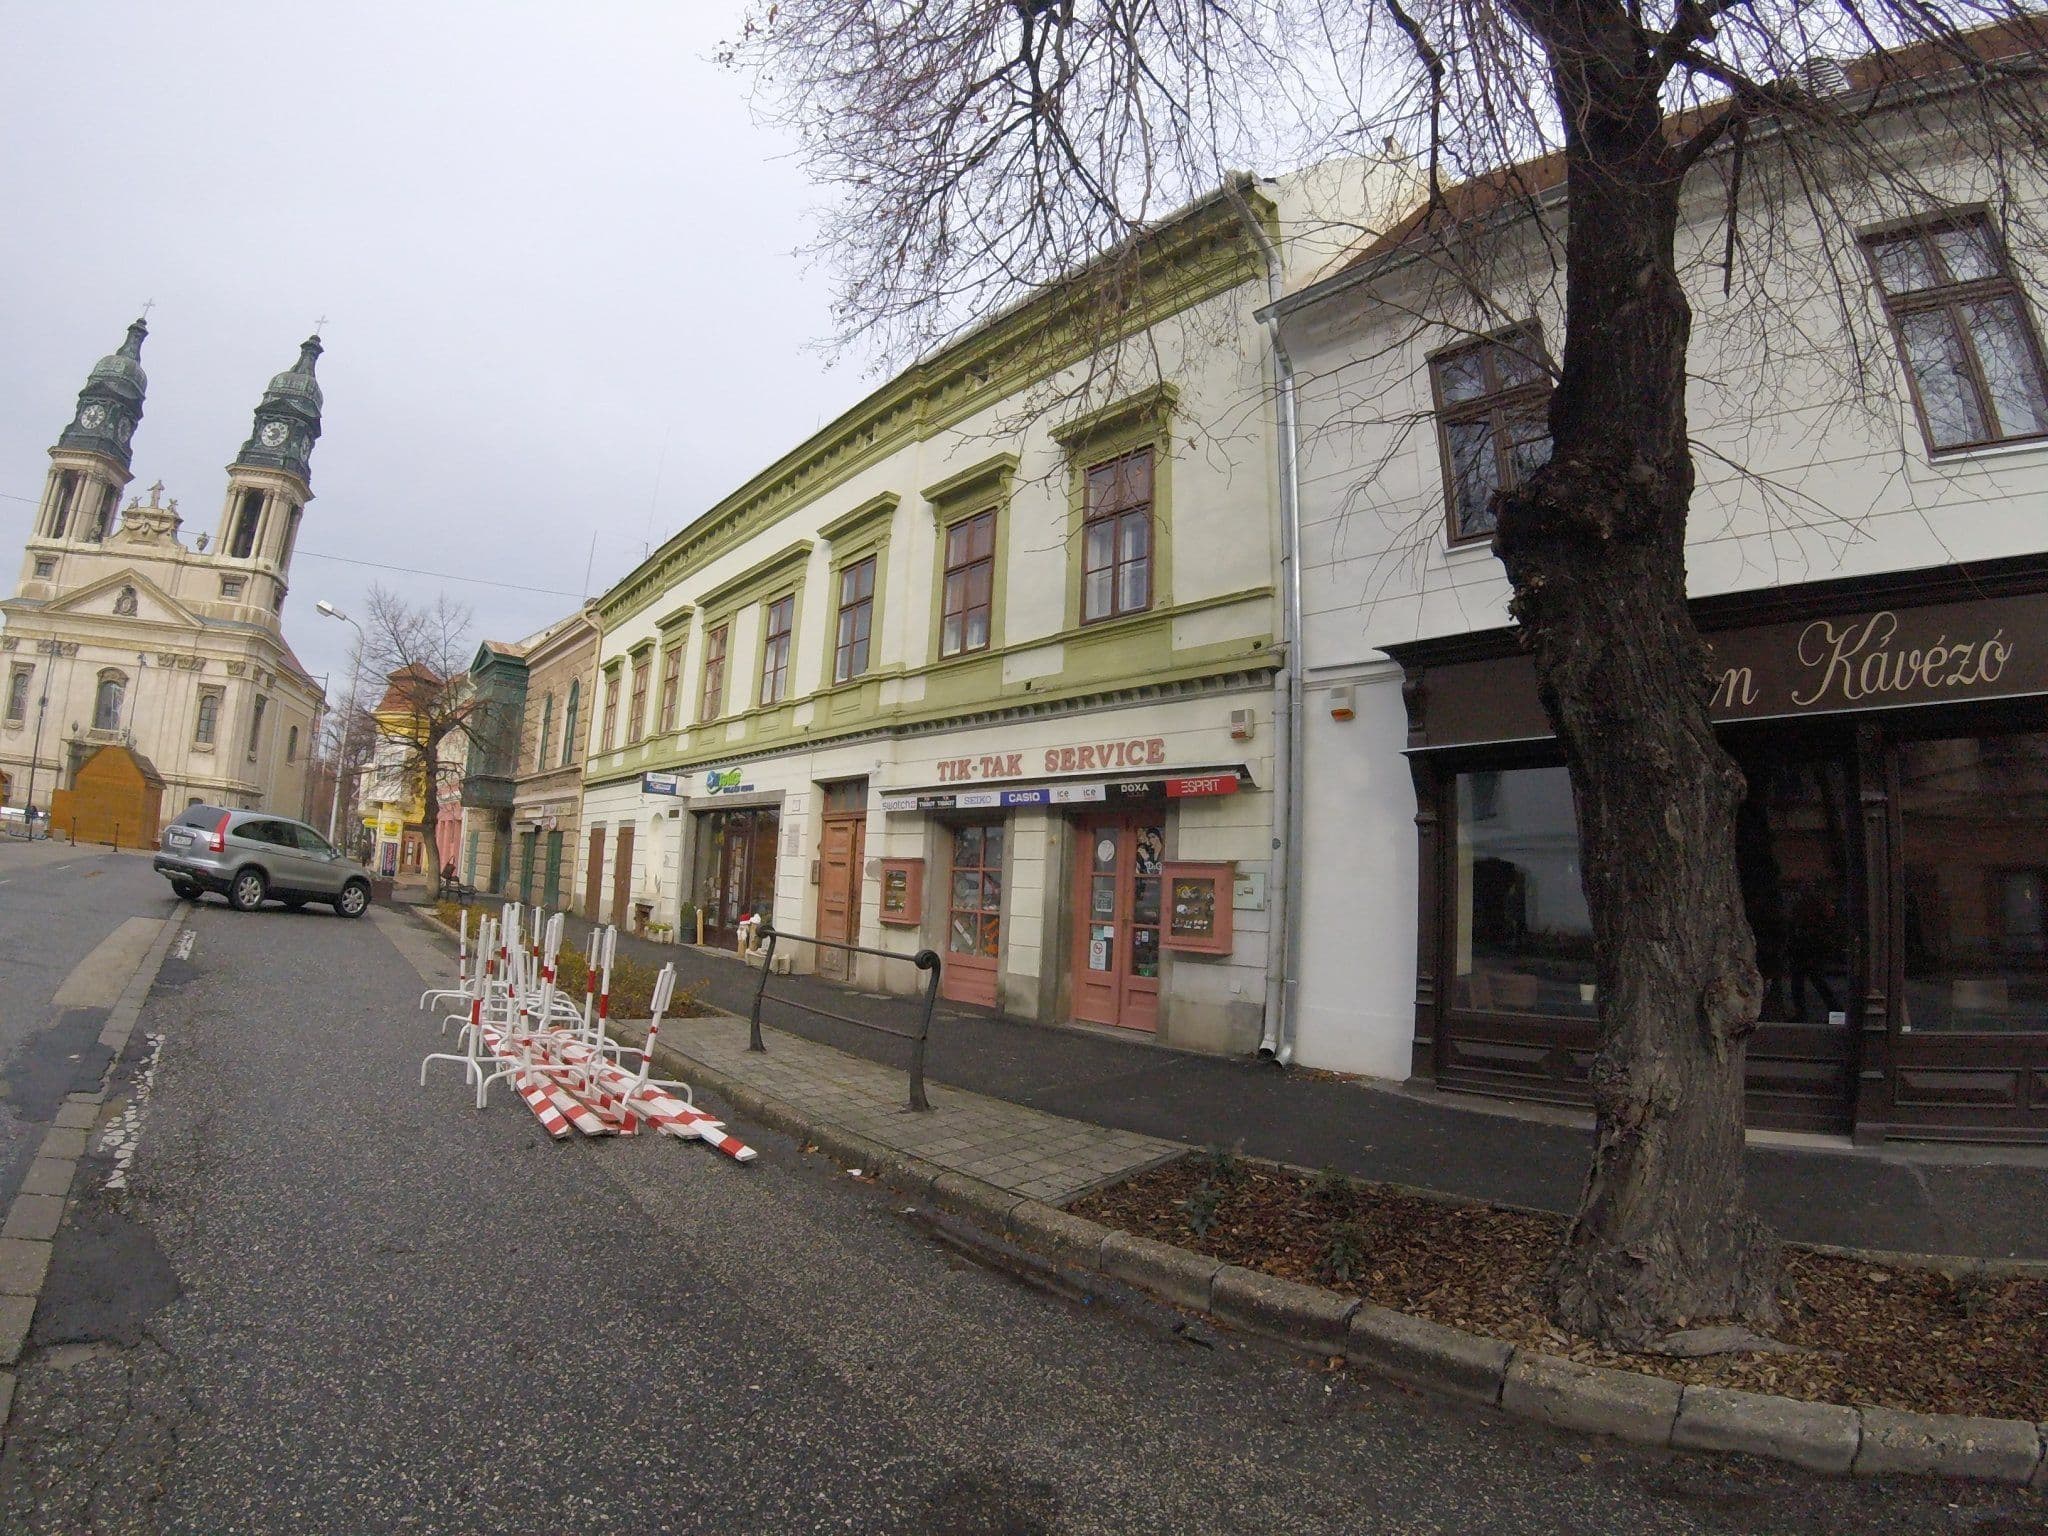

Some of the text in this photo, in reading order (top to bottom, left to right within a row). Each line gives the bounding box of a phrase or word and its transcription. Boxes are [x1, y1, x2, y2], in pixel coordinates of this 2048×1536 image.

[1791, 611, 2013, 705] Kávézó
[1044, 738, 1166, 773] SERVICE
[1120, 783, 1150, 793] DOXA
[1181, 778, 1220, 794] ESPRIT
[963, 795, 992, 805] SEIKO
[1008, 792, 1041, 804] CASIO
